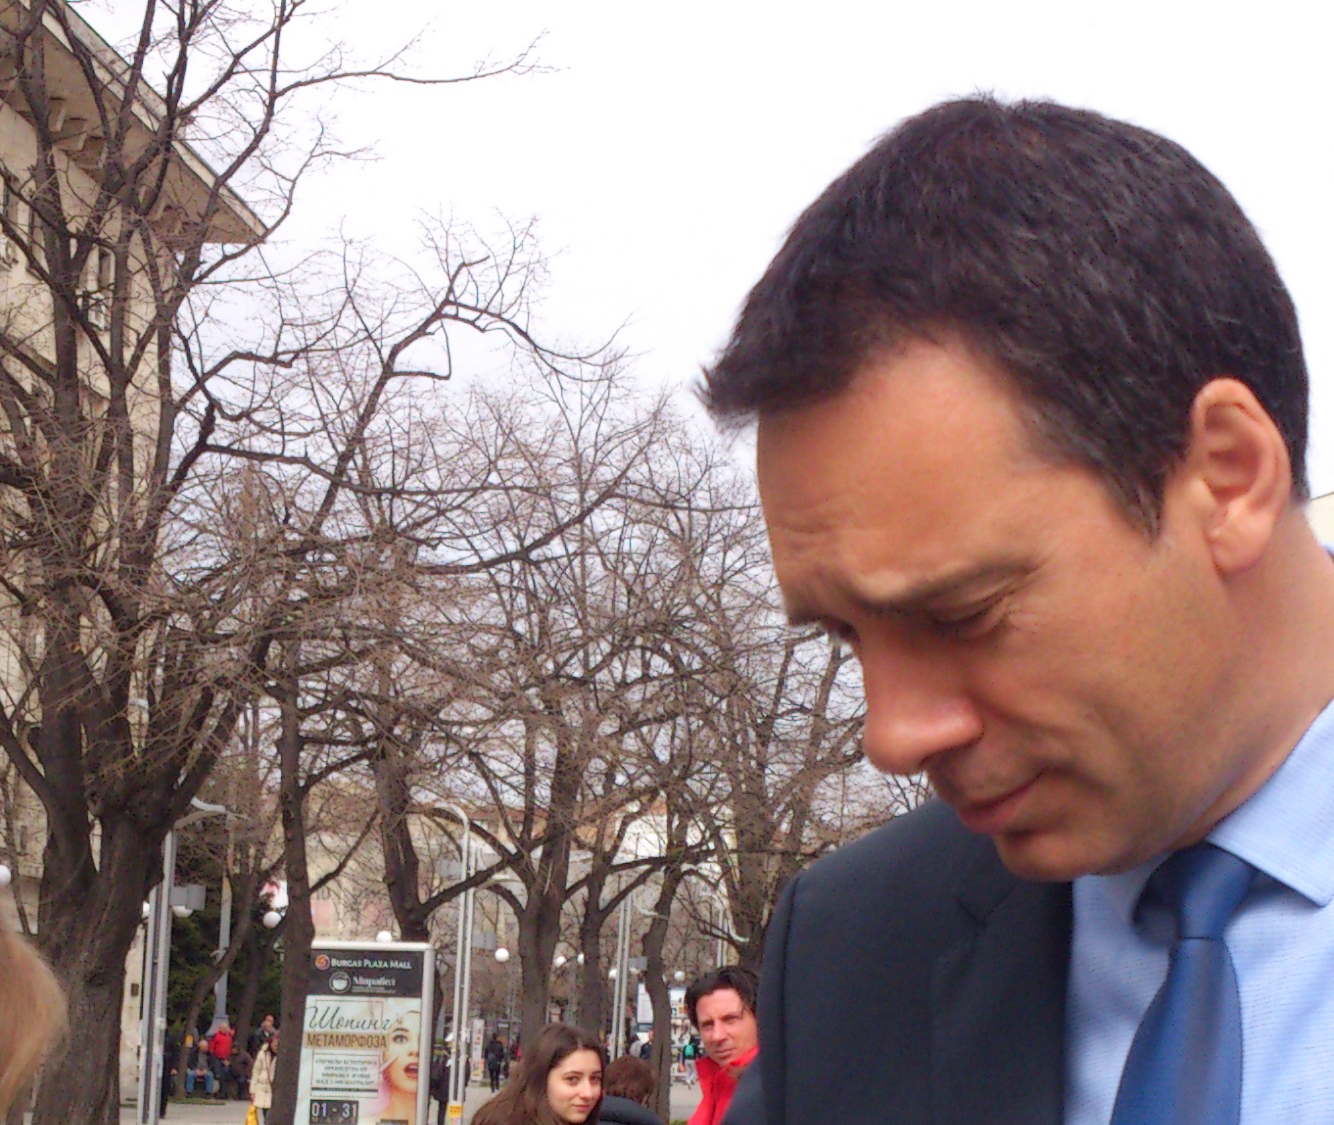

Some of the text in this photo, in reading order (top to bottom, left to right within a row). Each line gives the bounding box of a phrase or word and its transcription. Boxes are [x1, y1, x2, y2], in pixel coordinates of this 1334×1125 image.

[331, 958, 412, 969] BURGAS PLAZA MALL
[306, 1006, 392, 1031] Шопинг
[307, 1034, 387, 1048] МЕТАМОРФОЗА
[312, 1102, 327, 1117] 01
[342, 1103, 357, 1118] 31
